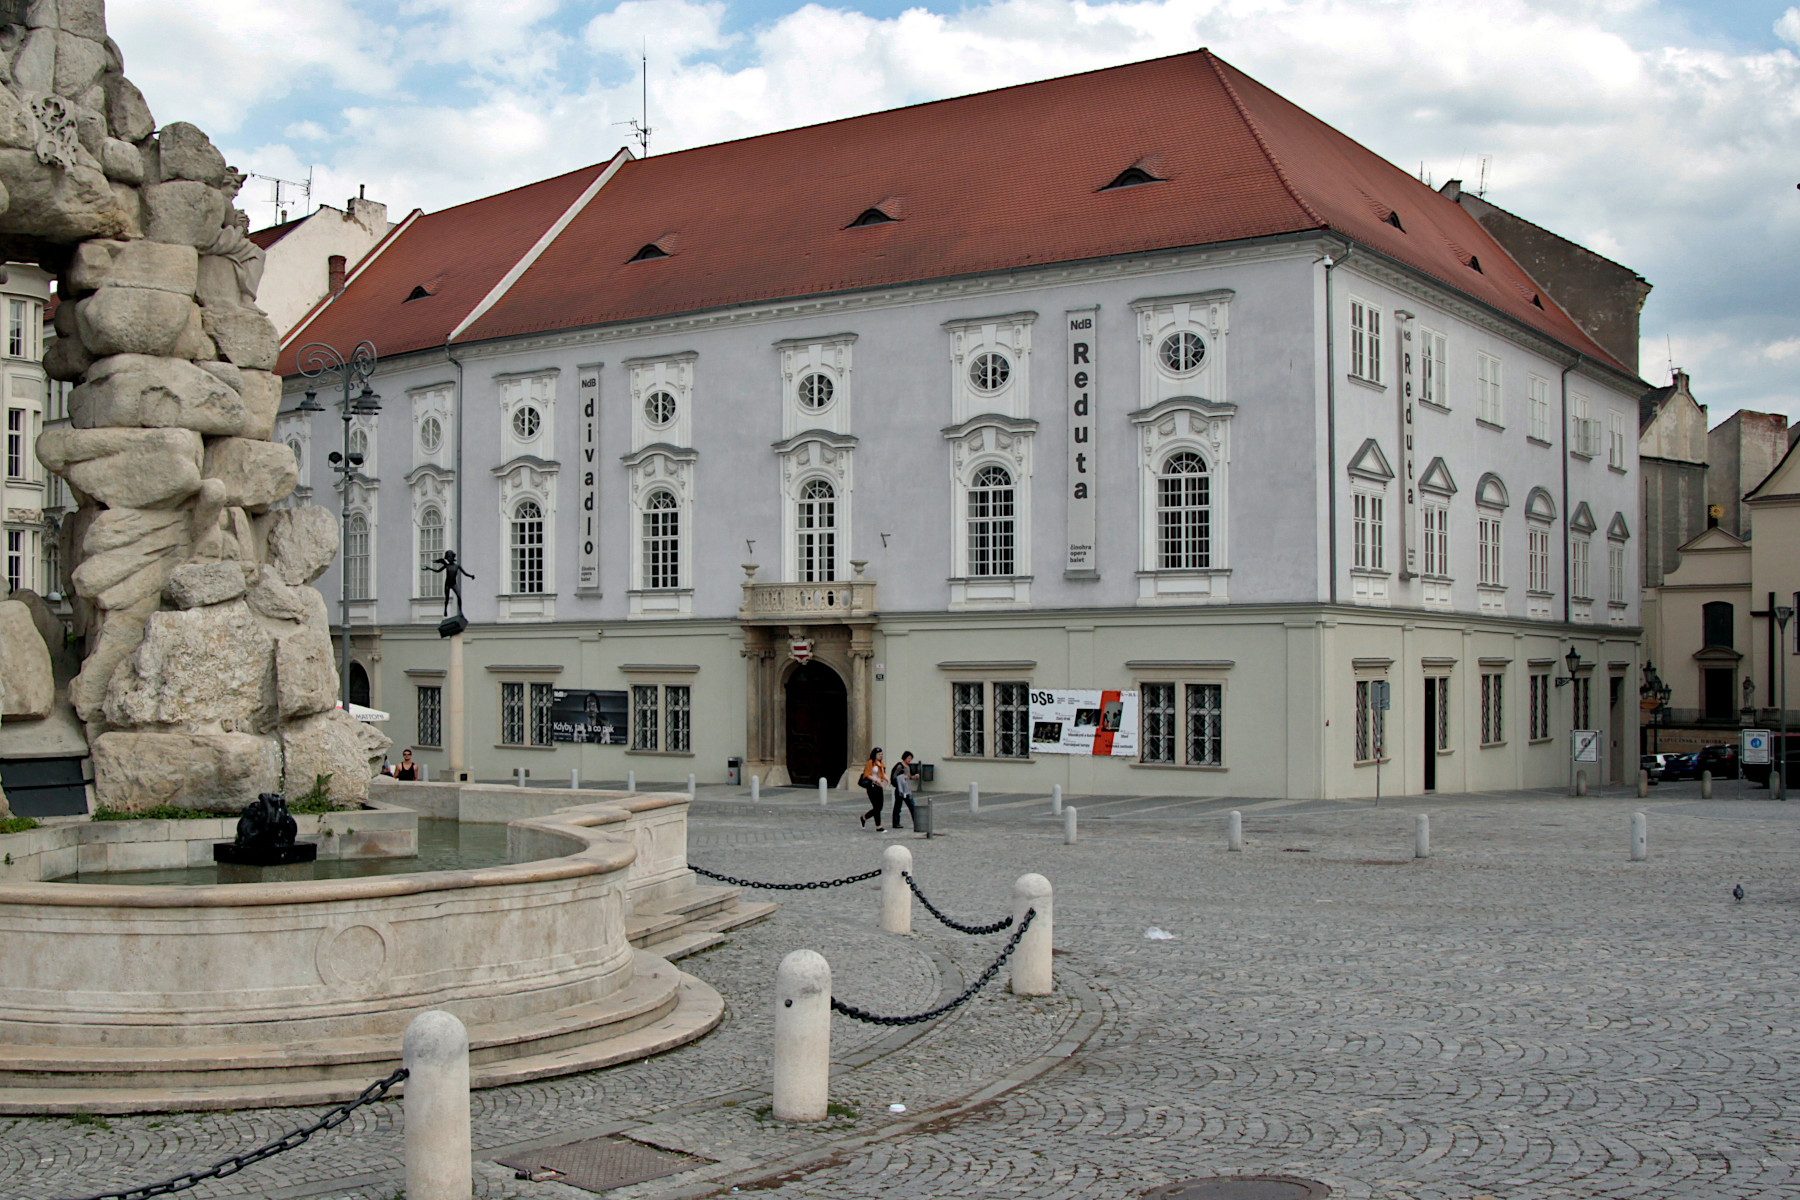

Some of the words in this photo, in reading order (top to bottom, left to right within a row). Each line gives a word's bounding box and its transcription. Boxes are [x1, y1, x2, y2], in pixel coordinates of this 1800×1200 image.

[1070, 318, 1092, 331] NdB
[581, 378, 597, 389] NdB
[1073, 342, 1090, 500] Reduta
[1404, 352, 1414, 505] Reduta
[584, 398, 595, 555] divadlo
[1031, 691, 1055, 706] DSB
